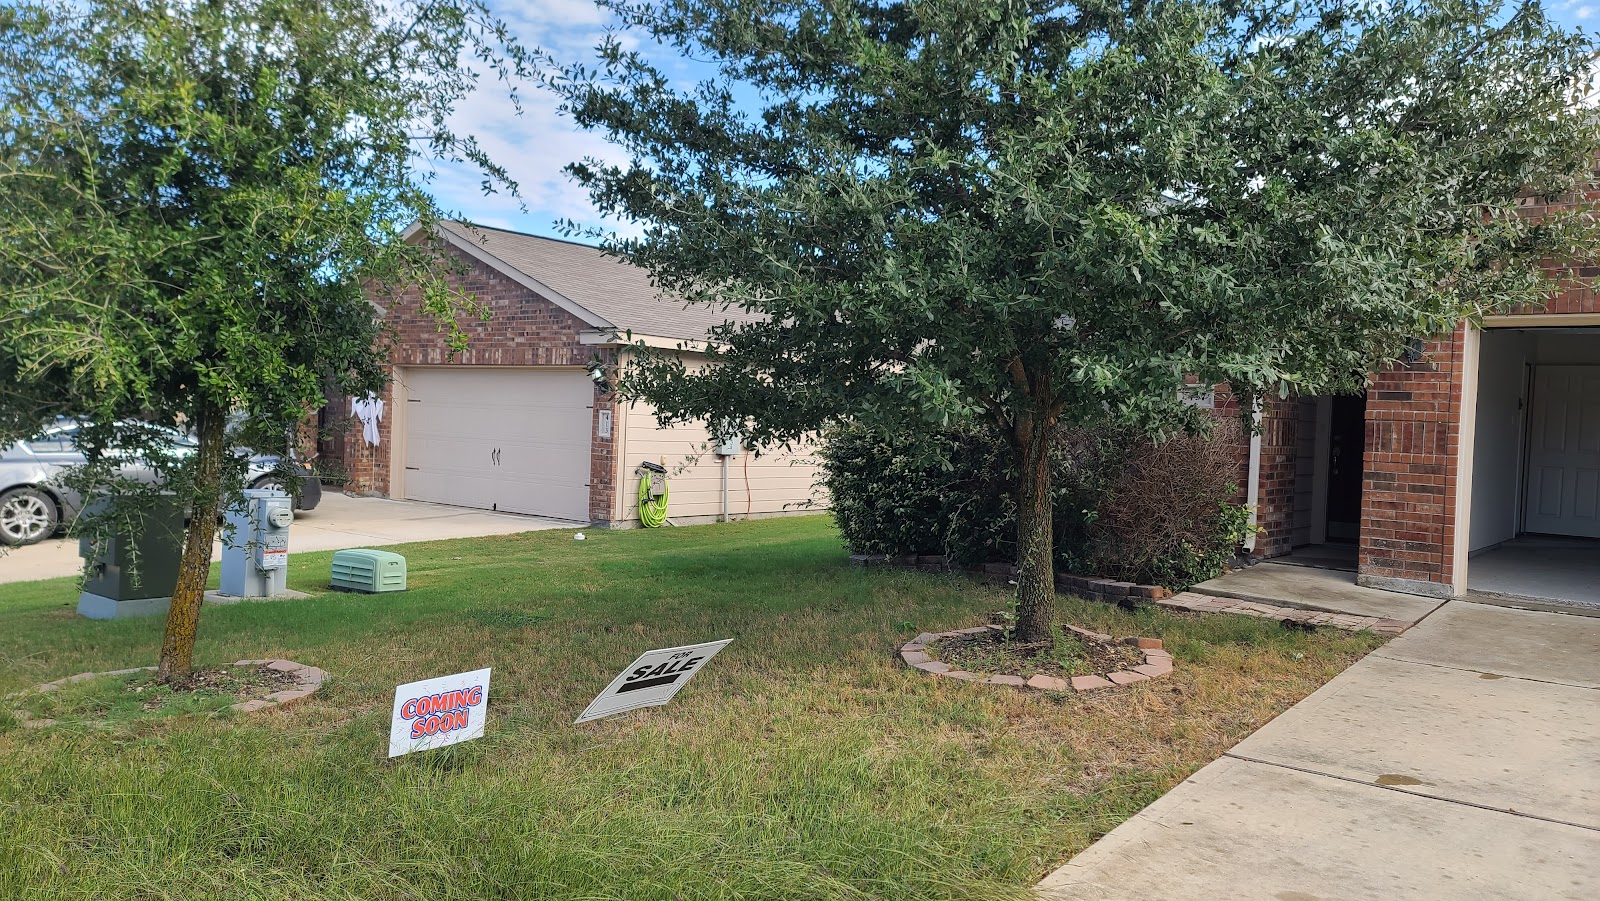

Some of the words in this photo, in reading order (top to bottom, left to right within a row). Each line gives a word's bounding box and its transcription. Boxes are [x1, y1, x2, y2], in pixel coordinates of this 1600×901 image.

[626, 656, 705, 681] SALE
[668, 651, 693, 660] FOR
[401, 685, 482, 720] COMING
[410, 708, 469, 739] SOON
